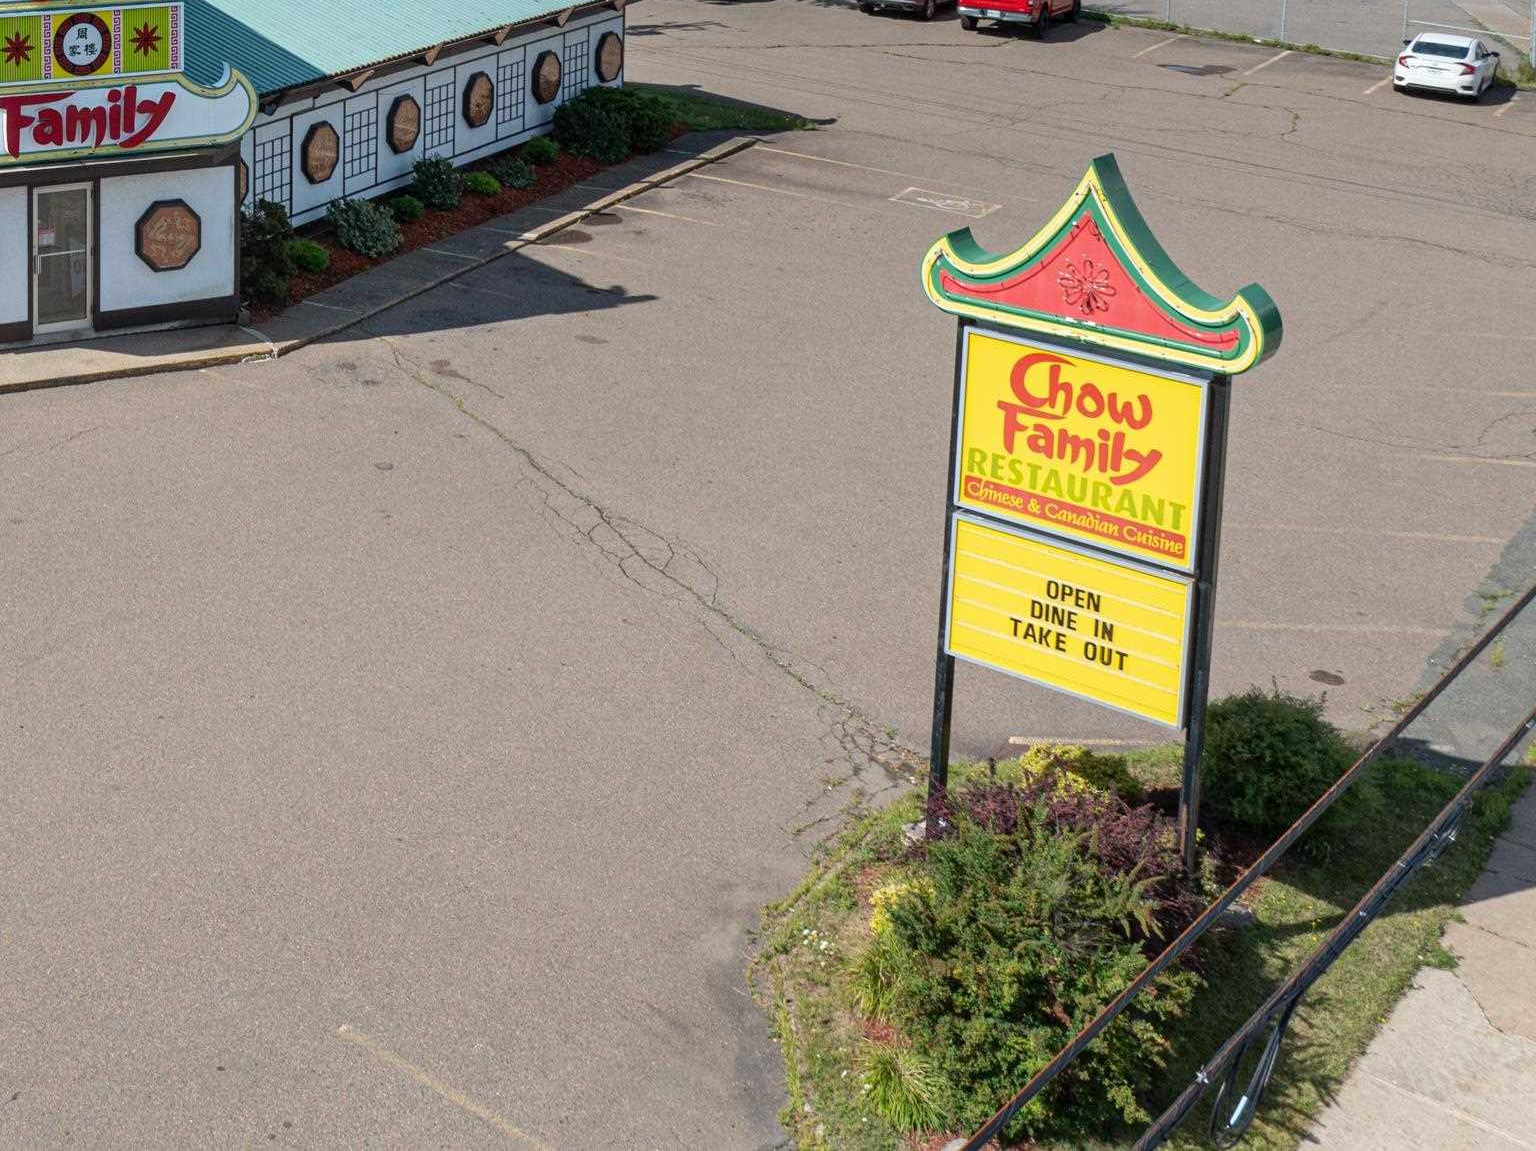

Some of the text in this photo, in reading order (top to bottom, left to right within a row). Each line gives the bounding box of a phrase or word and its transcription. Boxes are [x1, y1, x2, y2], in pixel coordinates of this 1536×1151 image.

[1009, 352, 1153, 430] Chow
[996, 399, 1163, 485] Family
[966, 447, 1186, 532] RESTAURANT
[967, 479, 1184, 555] Chinese & Canadian Cuisine
[1030, 600, 1114, 643] DINE IN
[1046, 580, 1101, 613] OPEN
[1010, 617, 1129, 672] TAKE OUT
